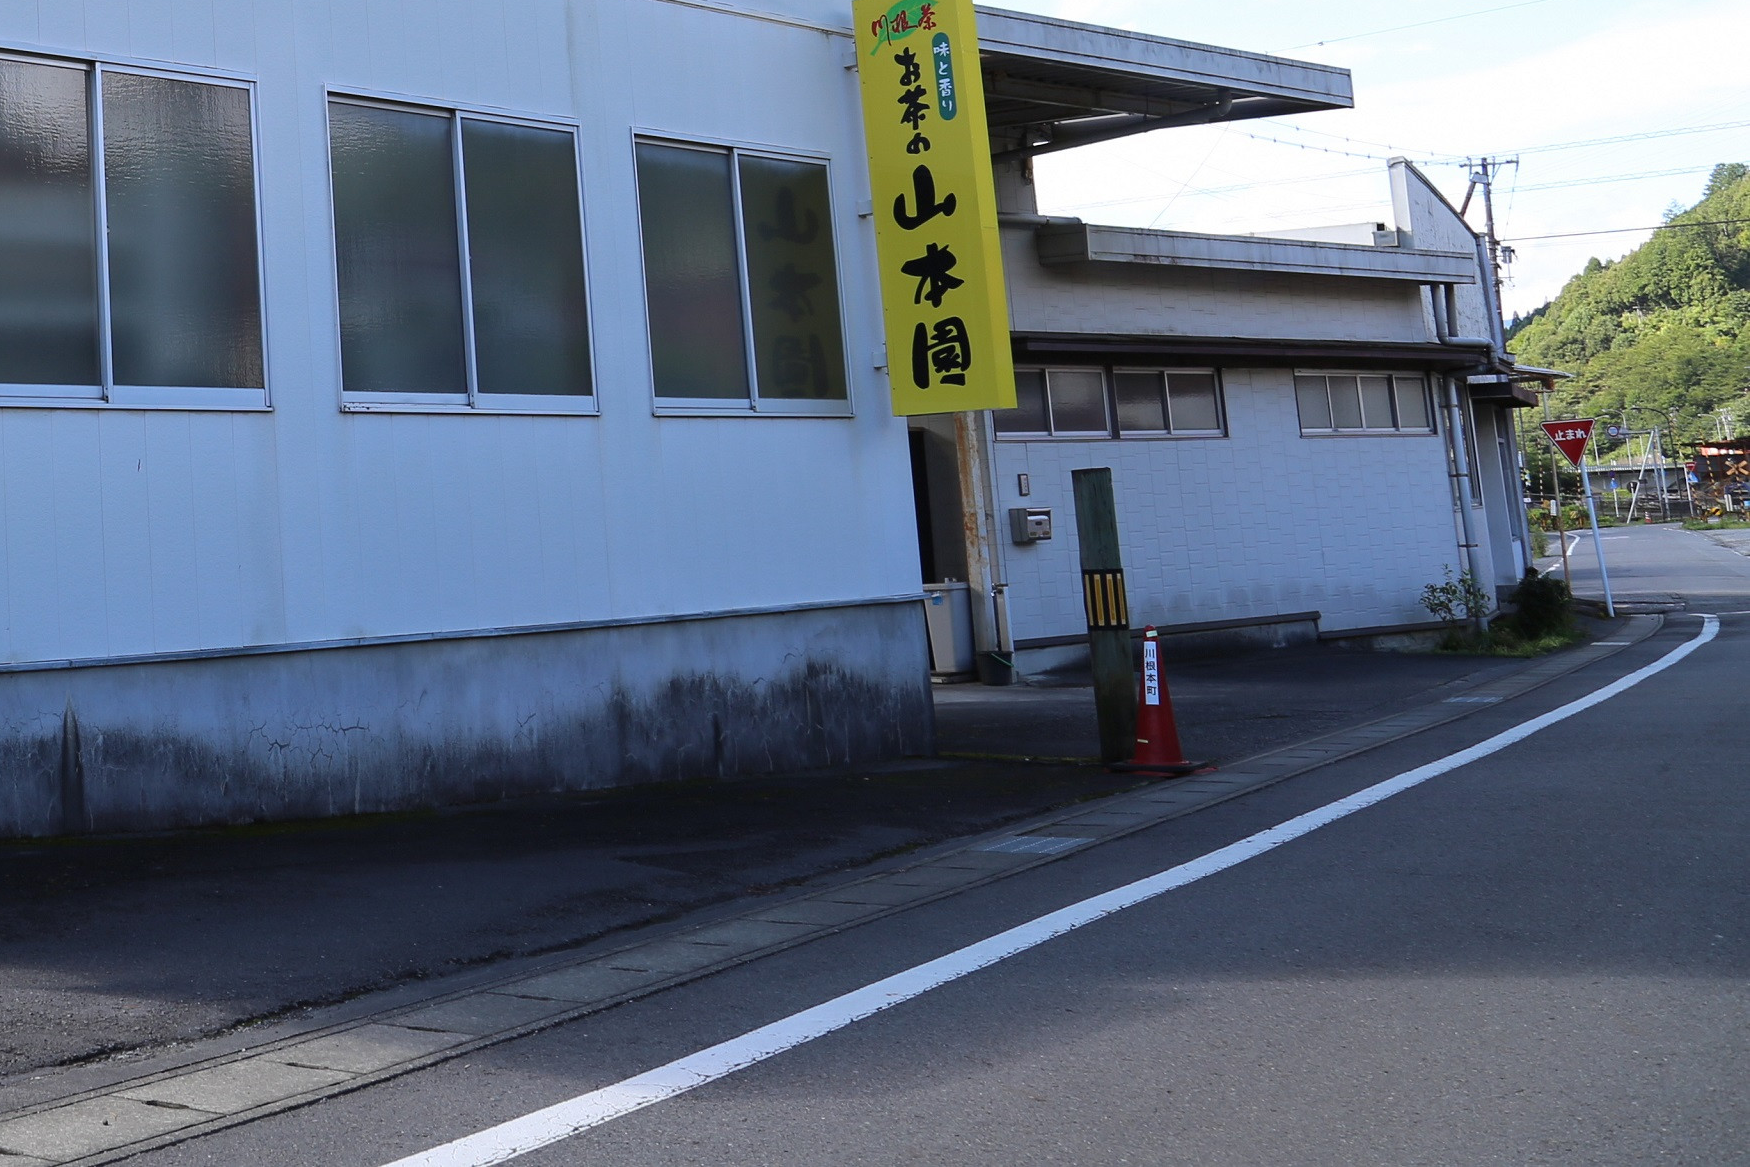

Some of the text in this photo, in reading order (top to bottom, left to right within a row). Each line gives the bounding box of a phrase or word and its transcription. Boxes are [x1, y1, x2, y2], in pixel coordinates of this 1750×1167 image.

[871, 2, 937, 47] 川根茶
[933, 43, 954, 112] 味と香り
[1555, 429, 1586, 441] 止まれ
[1144, 647, 1157, 696] 川根本町
